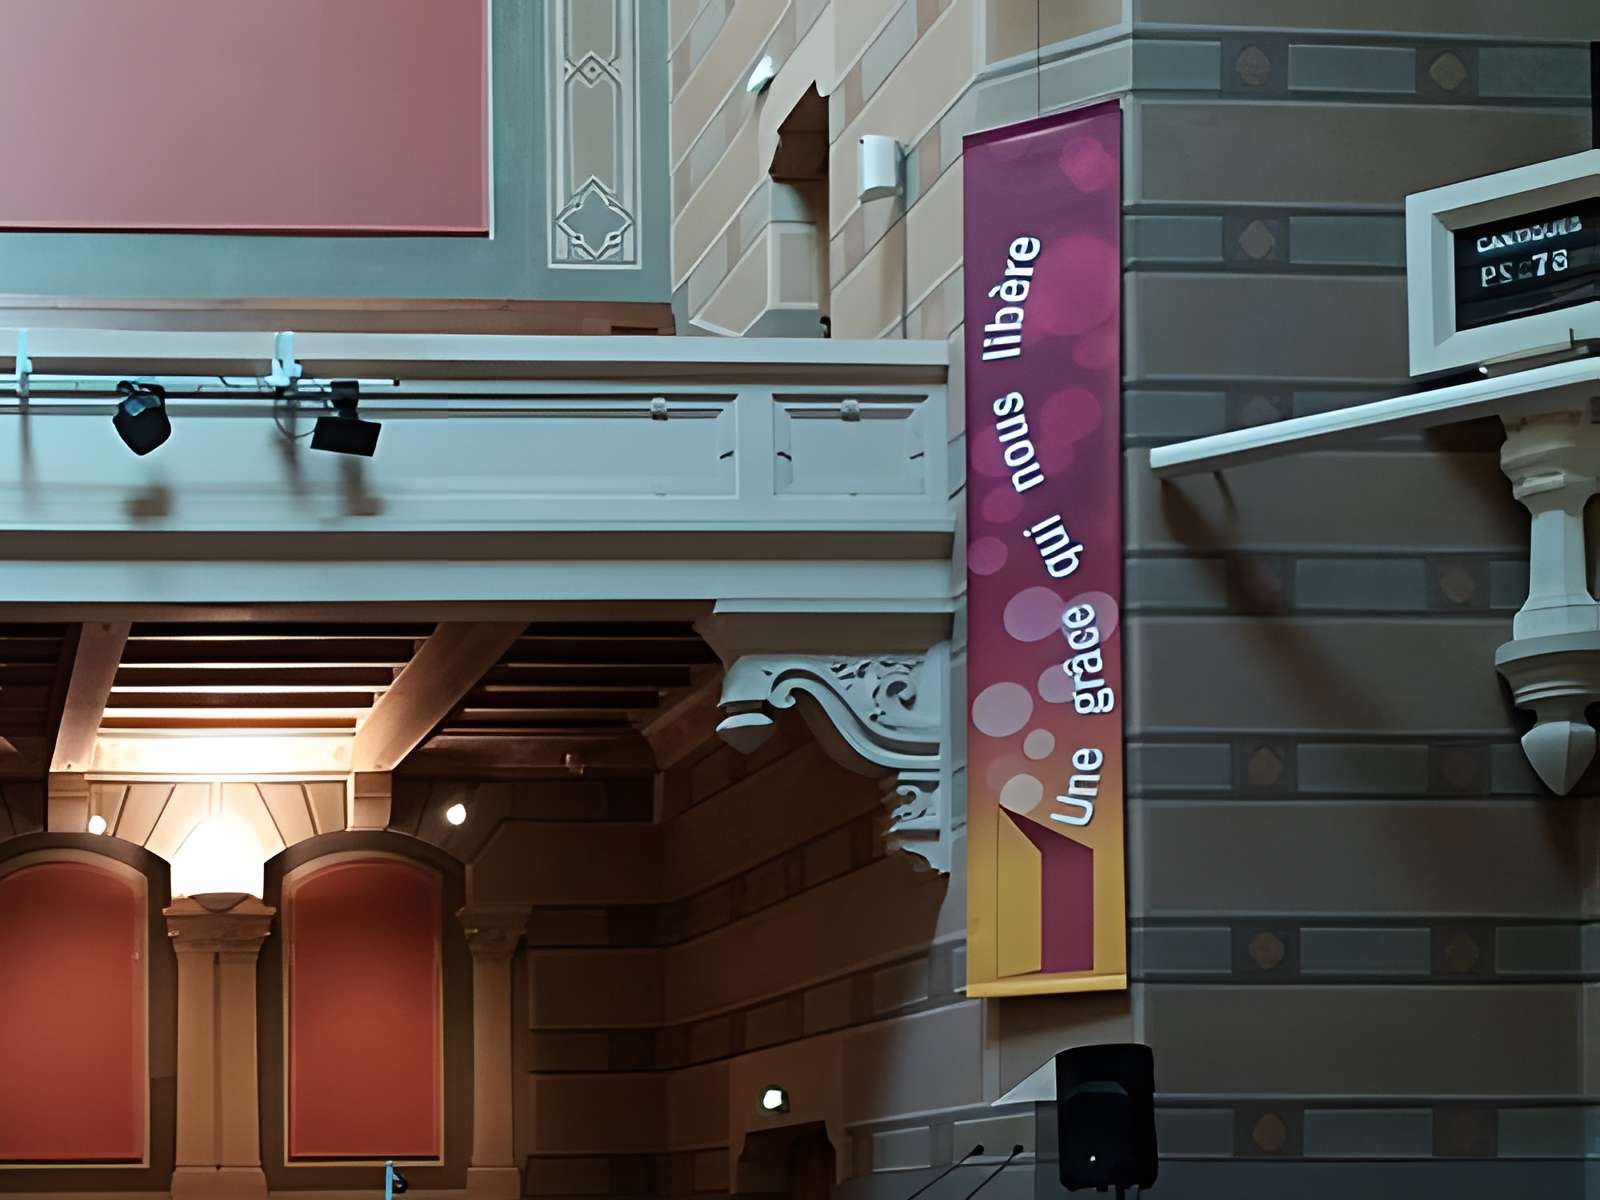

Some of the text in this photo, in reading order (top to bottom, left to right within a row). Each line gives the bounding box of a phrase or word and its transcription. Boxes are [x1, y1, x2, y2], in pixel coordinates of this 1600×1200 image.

[982, 236, 1114, 827] Une grâce qui nous libère
